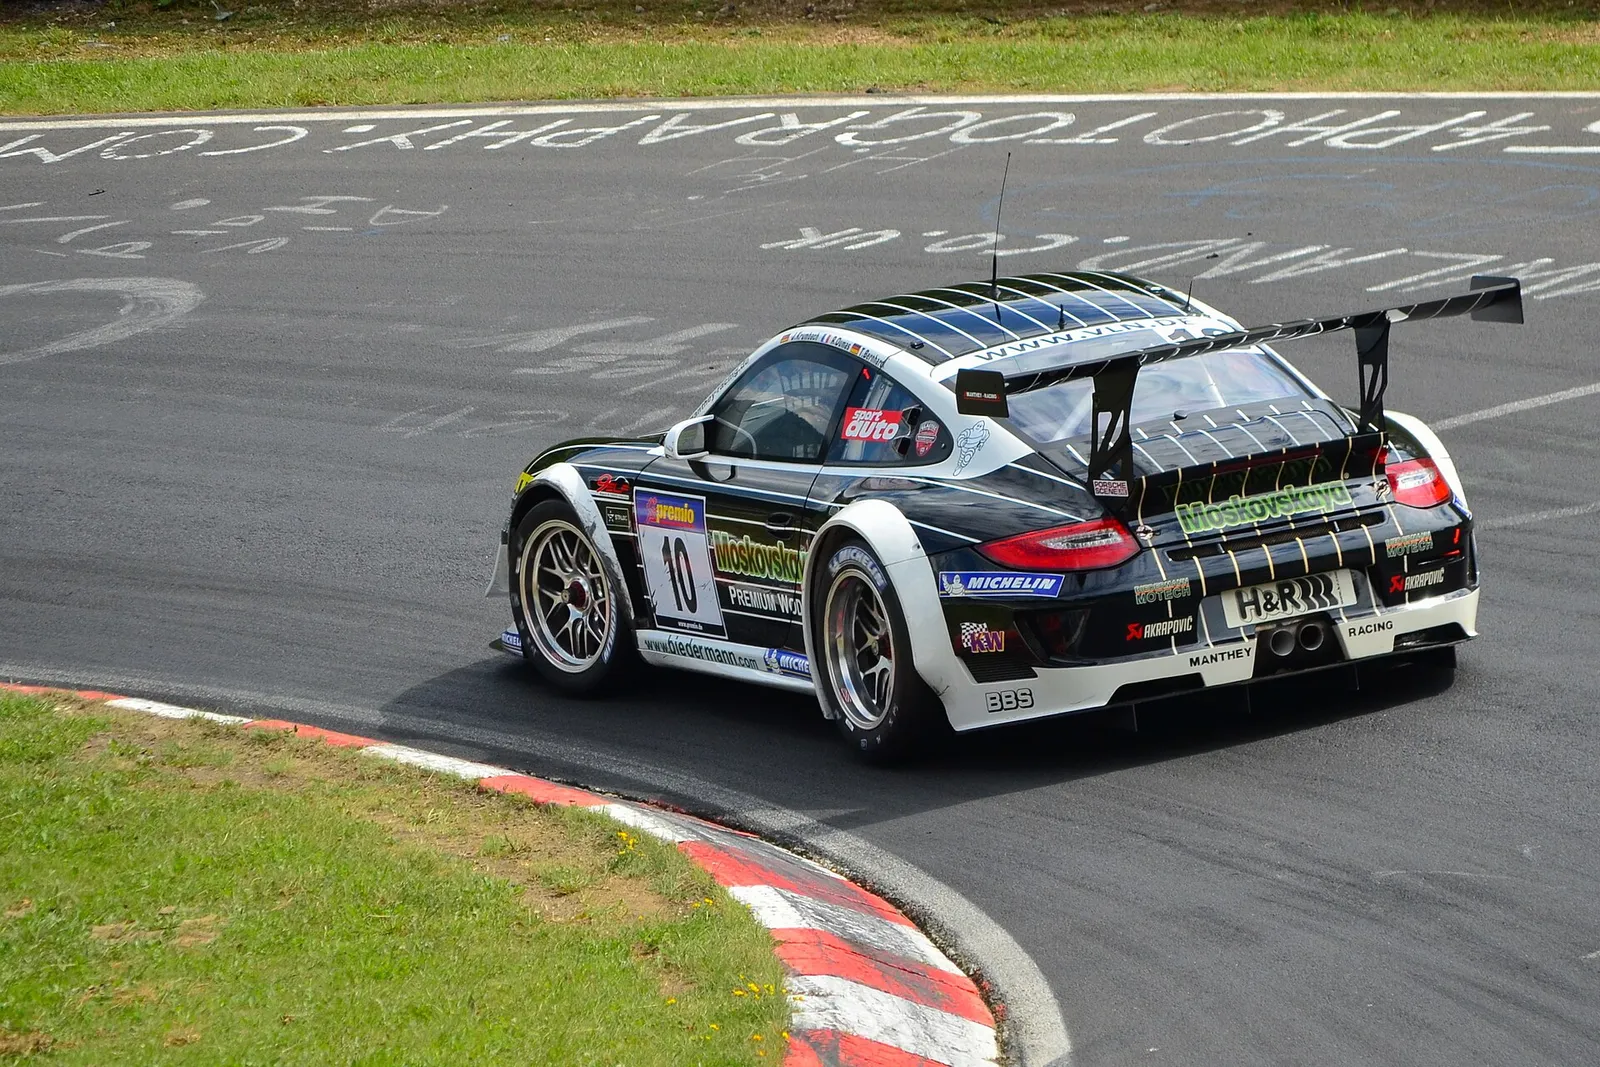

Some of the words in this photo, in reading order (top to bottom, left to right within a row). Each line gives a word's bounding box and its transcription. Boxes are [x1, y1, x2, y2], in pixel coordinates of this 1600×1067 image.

[852, 410, 883, 421] sport
[845, 420, 899, 440] auto
[1094, 481, 1126, 489] PORSCHE
[656, 503, 695, 524] premio
[1175, 480, 1352, 534] Moskovskaya
[1386, 540, 1434, 558] MOTECH
[662, 536, 698, 614] 10
[967, 577, 1056, 589] MICHELIN
[729, 586, 777, 611] PREMIUM
[1135, 586, 1191, 605] MOTECH
[1235, 578, 1308, 622] H&R
[645, 635, 759, 669] www.biedermann.com
[971, 631, 1005, 653] KW
[1190, 647, 1252, 667] MANTHEY
[1348, 620, 1394, 637] RACING
[985, 688, 1034, 713] BBS
